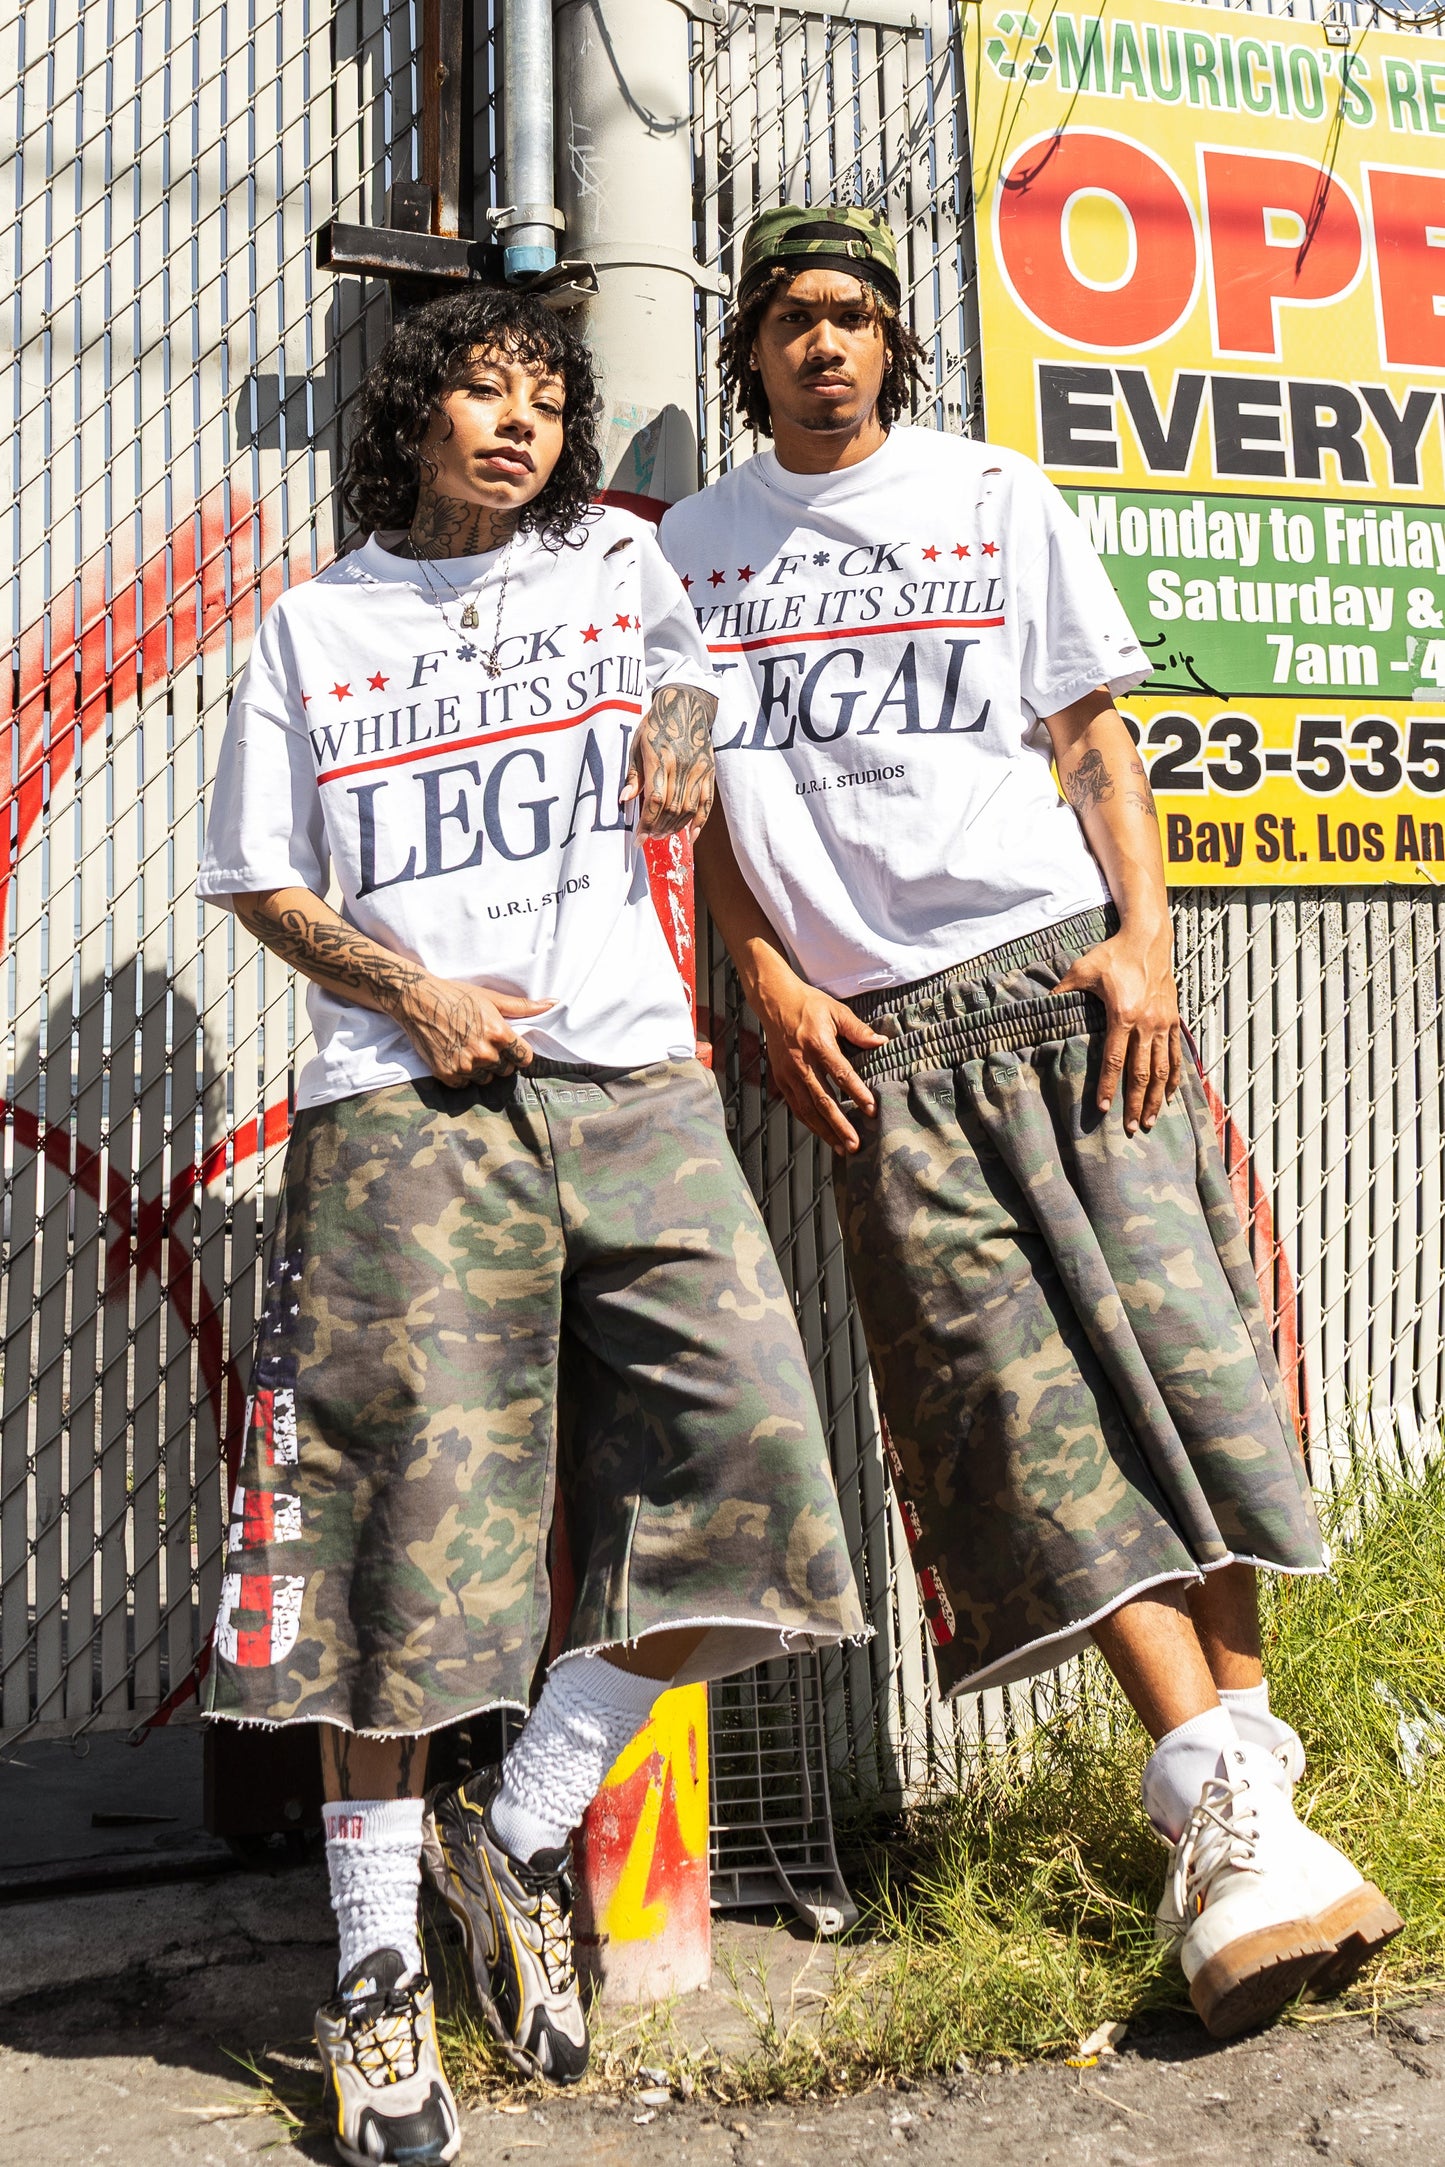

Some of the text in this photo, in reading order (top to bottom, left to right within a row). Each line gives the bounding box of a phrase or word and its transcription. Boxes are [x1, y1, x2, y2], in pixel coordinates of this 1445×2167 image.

[1055, 16, 1445, 133] MAURICIO'S RE
[997, 132, 1445, 368] OPE
[1038, 364, 1445, 486] EVERY
[1077, 494, 1261, 567] Monday
[1268, 503, 1315, 564] to
[813, 585, 883, 627] IT'S
[894, 578, 1006, 617] STILL
[1147, 568, 1445, 632] Saturday &
[1266, 633, 1380, 687] 7am
[309, 655, 644, 767] WHILE IT'S STILL
[795, 764, 905, 796] U.R.i. STUDIOS
[1120, 715, 1445, 793] 23-535
[346, 723, 635, 900] LEGAL
[1166, 813, 1445, 868] Bay St. Los An
[487, 898, 539, 920] U.R.i.
